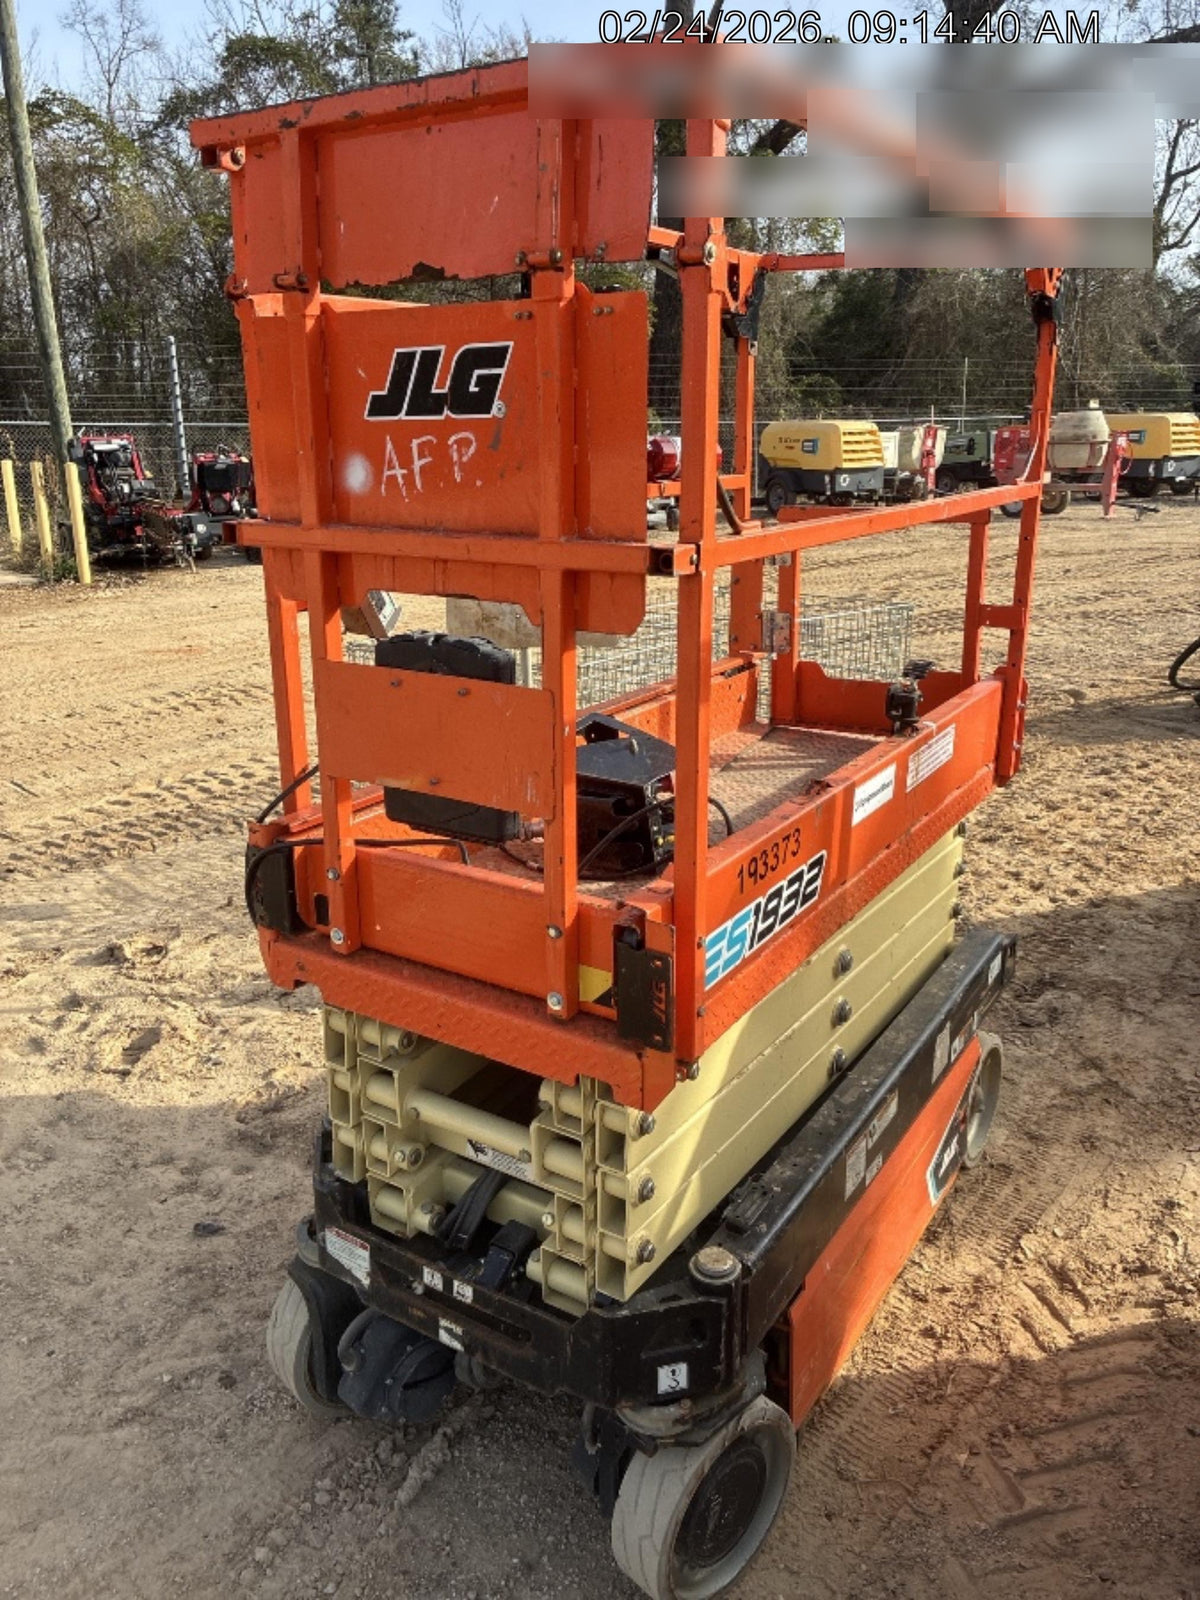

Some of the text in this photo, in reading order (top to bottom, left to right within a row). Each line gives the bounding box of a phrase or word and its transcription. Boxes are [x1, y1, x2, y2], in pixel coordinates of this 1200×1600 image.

[364, 341, 514, 420] JLG
[737, 828, 801, 894] 193373
[704, 850, 827, 991] ES1932
